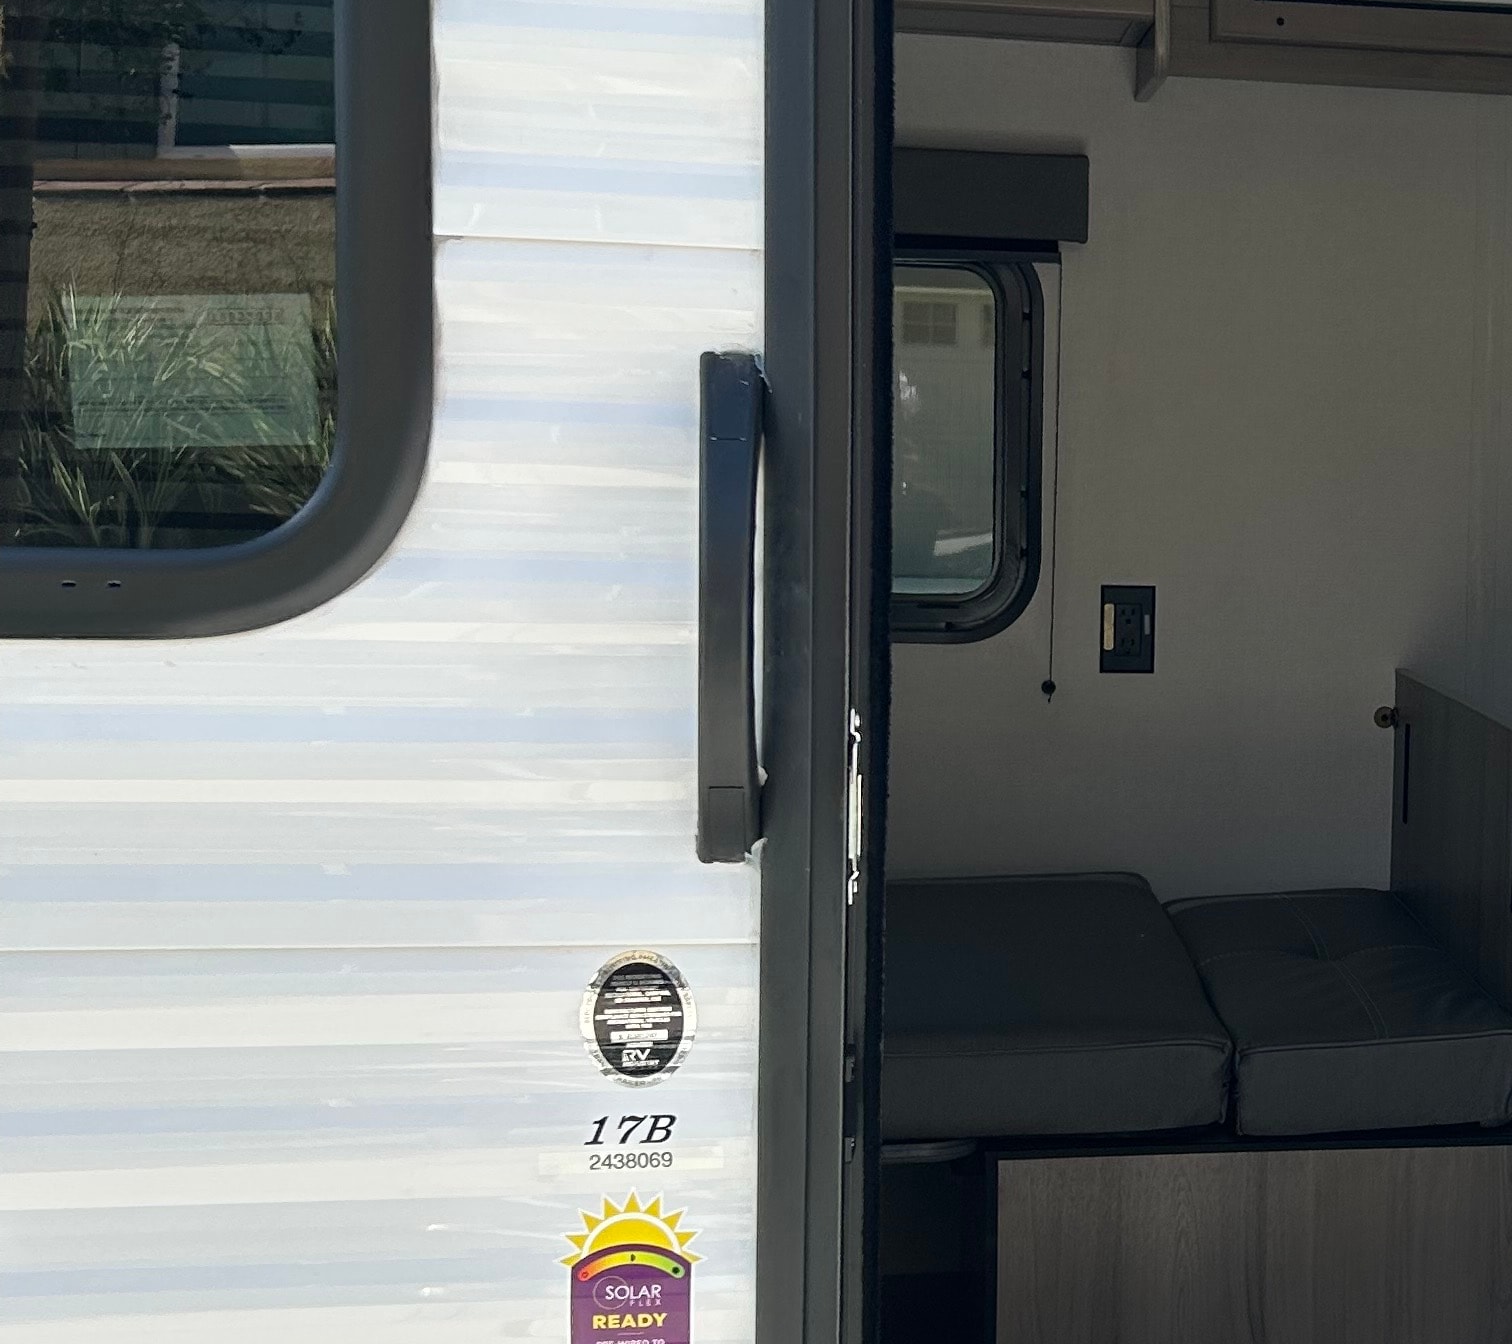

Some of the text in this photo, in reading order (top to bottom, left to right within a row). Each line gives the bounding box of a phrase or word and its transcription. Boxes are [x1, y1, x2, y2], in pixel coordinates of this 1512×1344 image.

[621, 1048, 650, 1061] RV
[583, 1114, 677, 1146] 17B
[589, 1152, 673, 1171] 2438069
[605, 1284, 661, 1300] SOLAR
[592, 1313, 668, 1329] READY
